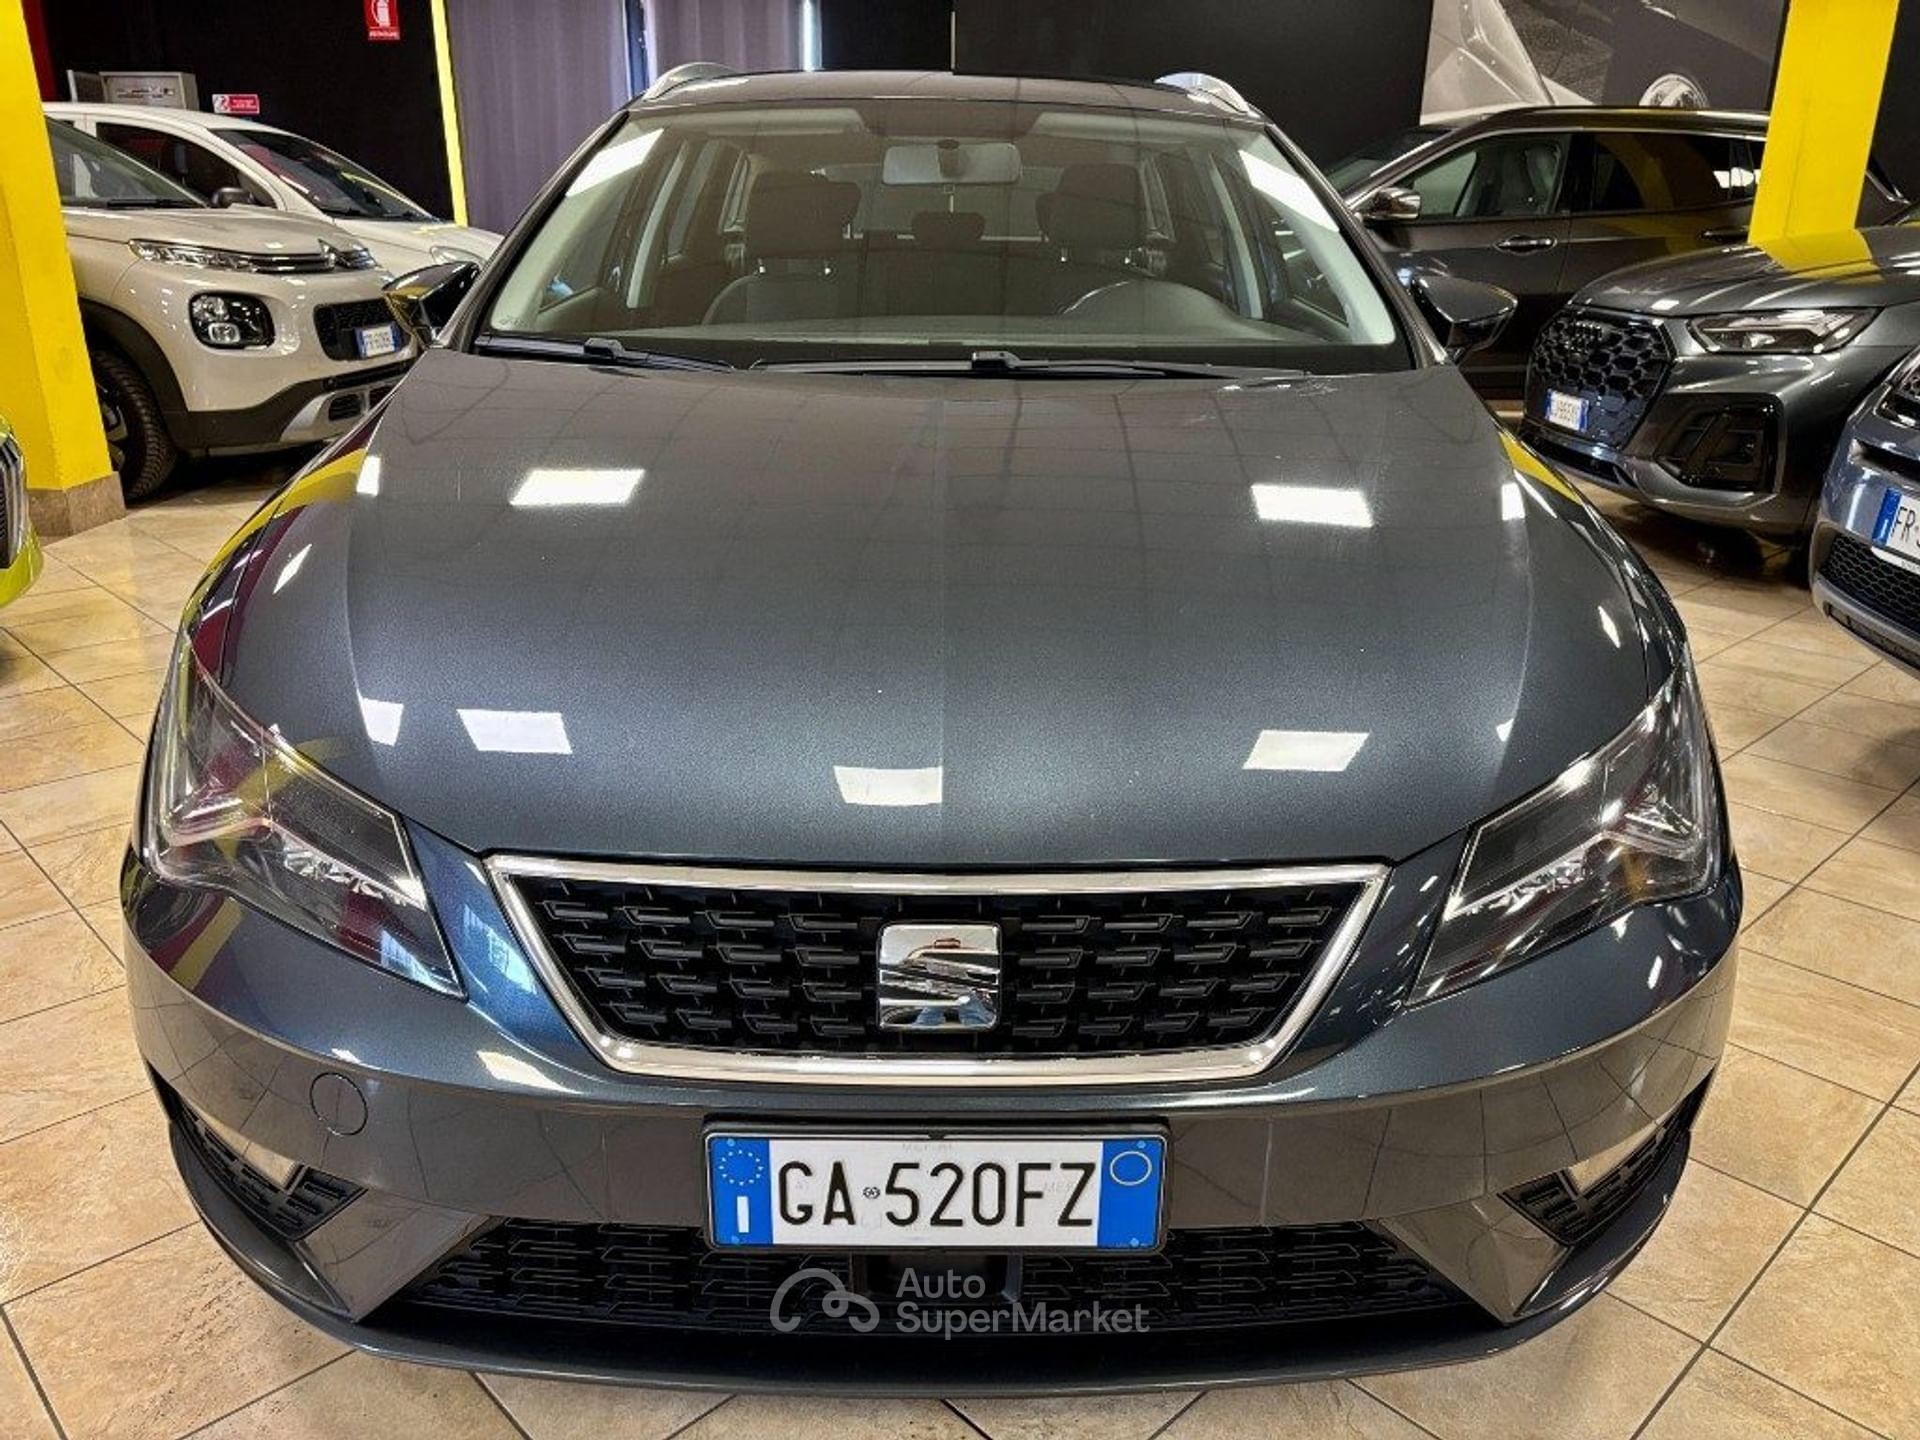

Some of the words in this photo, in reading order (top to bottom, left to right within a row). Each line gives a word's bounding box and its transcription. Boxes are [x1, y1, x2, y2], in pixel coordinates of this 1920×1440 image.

[736, 1196, 750, 1233] I
[778, 1161, 856, 1226] GA
[885, 1162, 1097, 1227] 520FZ
